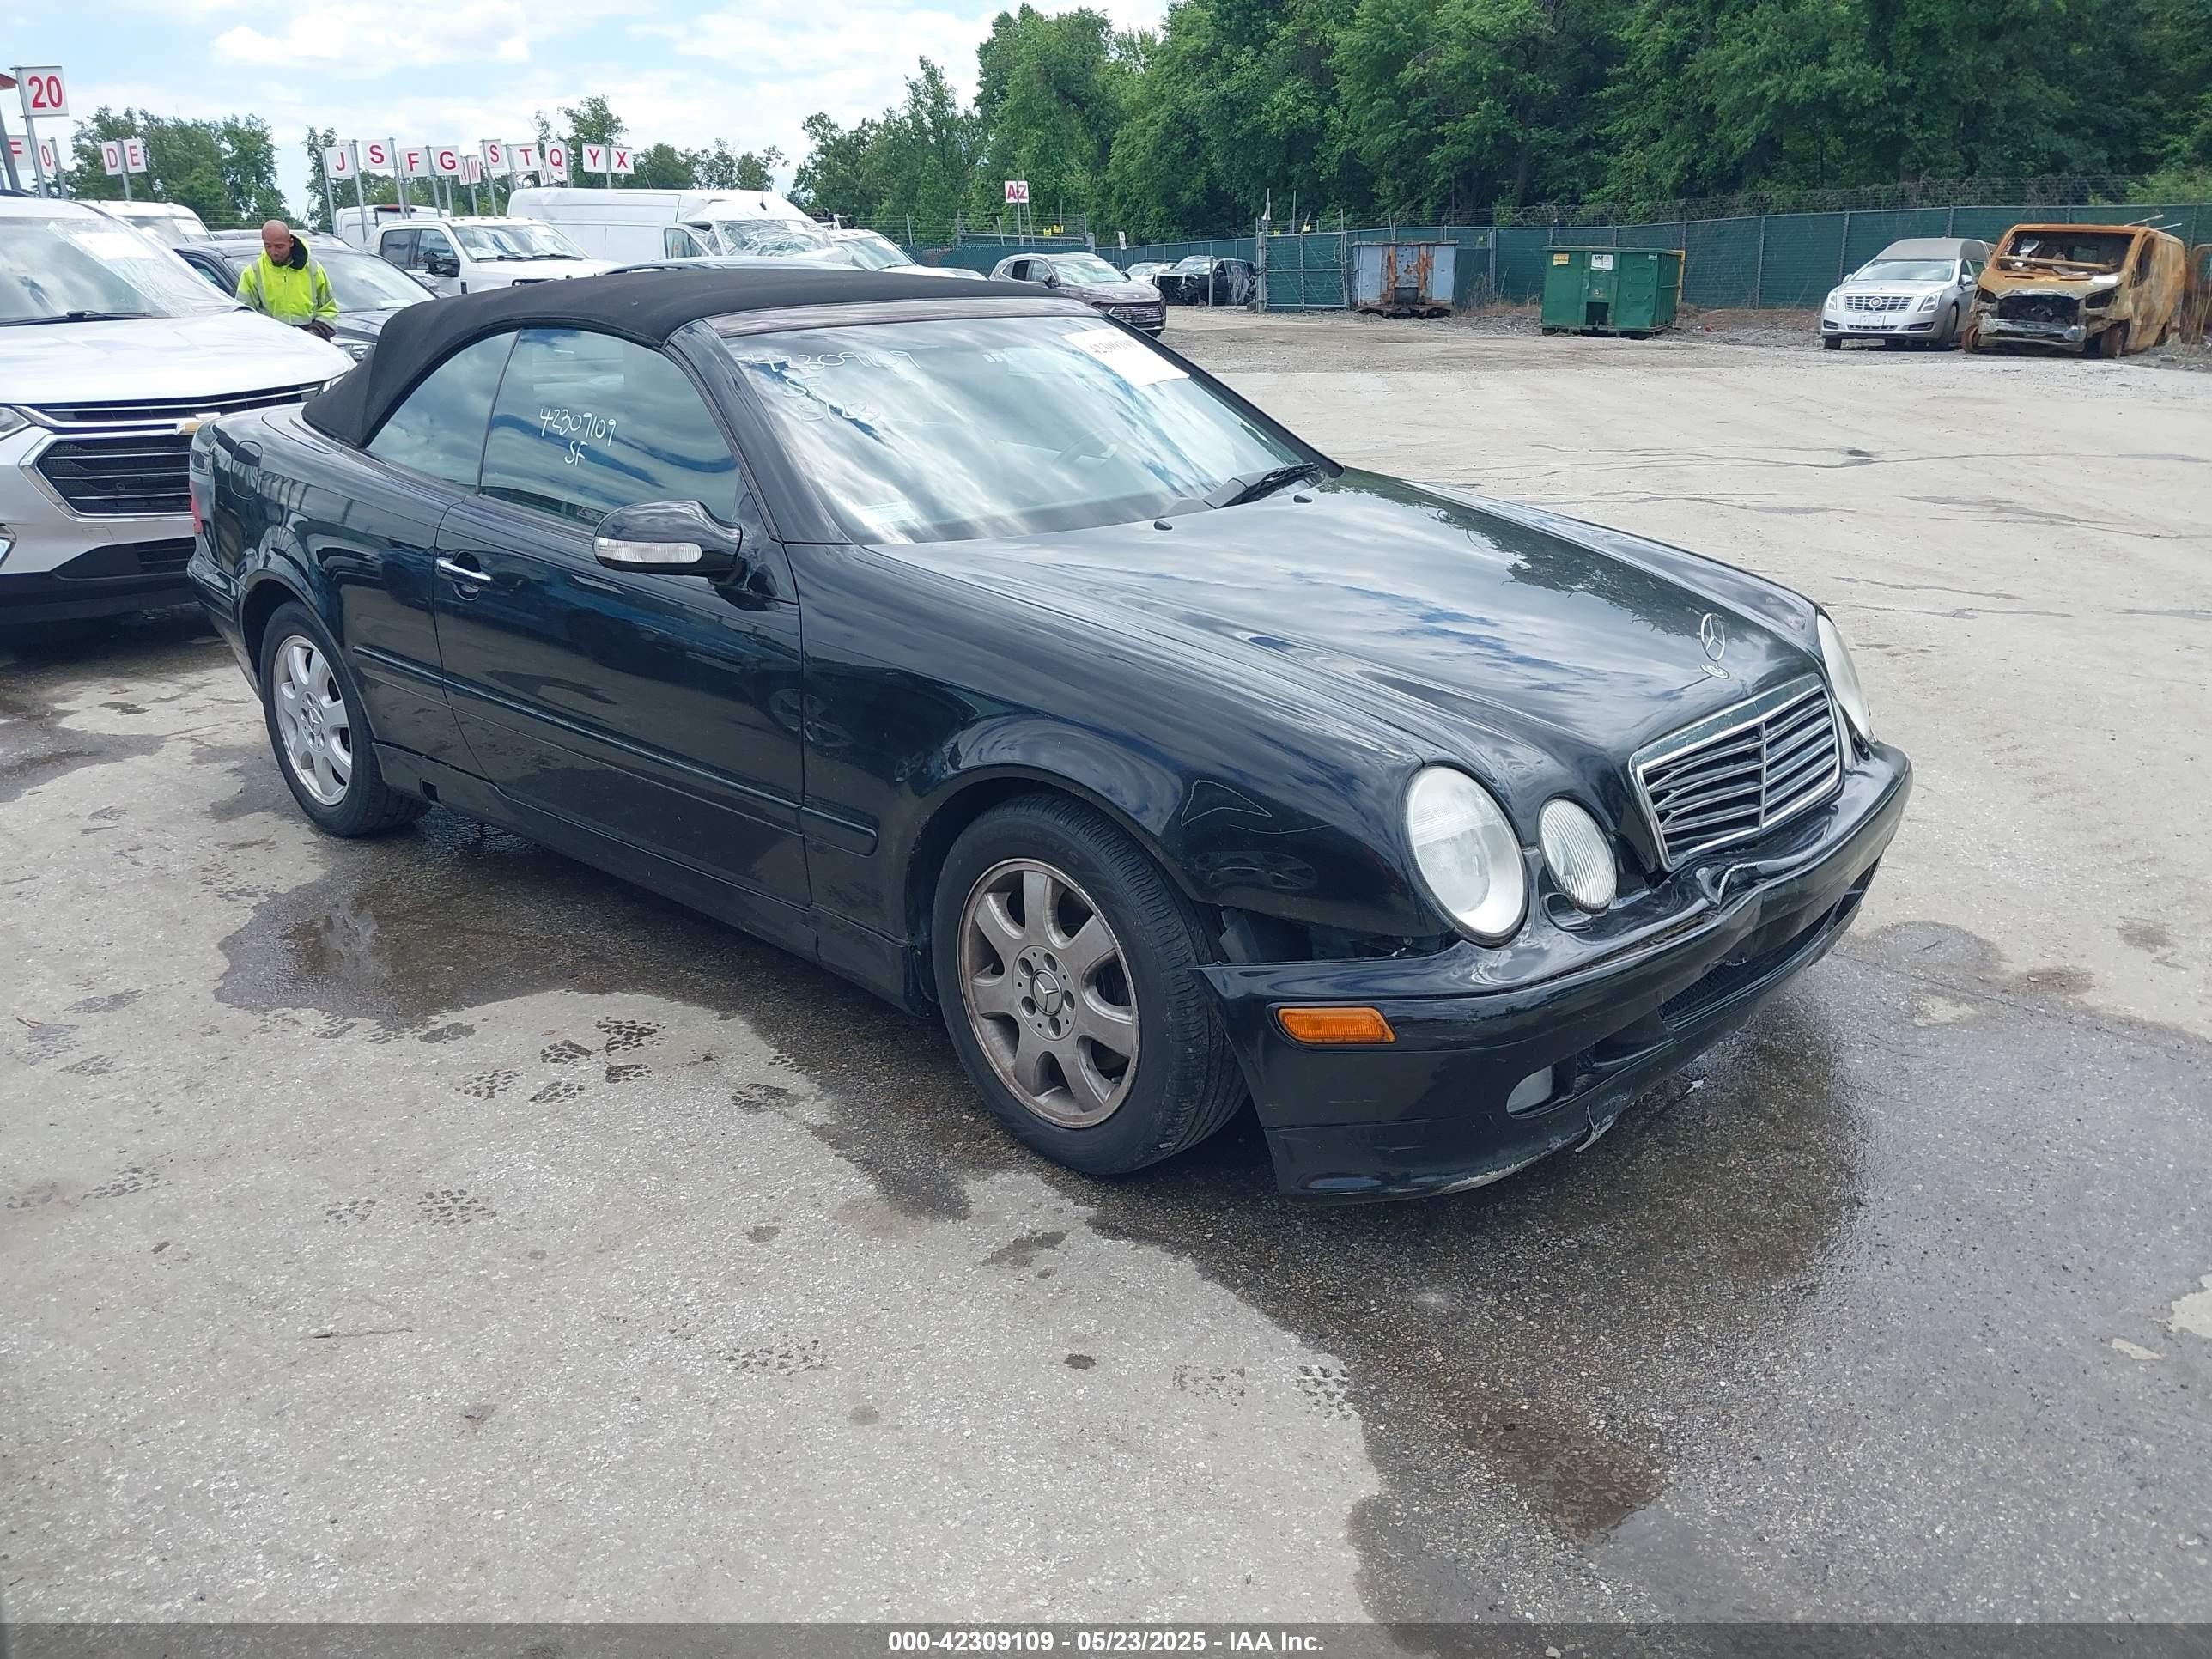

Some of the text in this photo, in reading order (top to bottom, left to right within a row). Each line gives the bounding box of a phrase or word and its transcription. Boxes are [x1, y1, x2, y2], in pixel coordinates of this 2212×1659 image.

[28, 76, 63, 108] 20
[106, 147, 118, 169] D
[129, 145, 141, 167] E
[335, 151, 346, 172] J
[368, 144, 385, 165] S
[407, 152, 420, 172] F
[439, 150, 457, 171] G
[489, 144, 500, 163] S
[519, 149, 532, 167] T
[550, 148, 563, 168] Q
[587, 149, 600, 167] Y
[616, 150, 629, 169] X
[563, 439, 589, 467] SF
